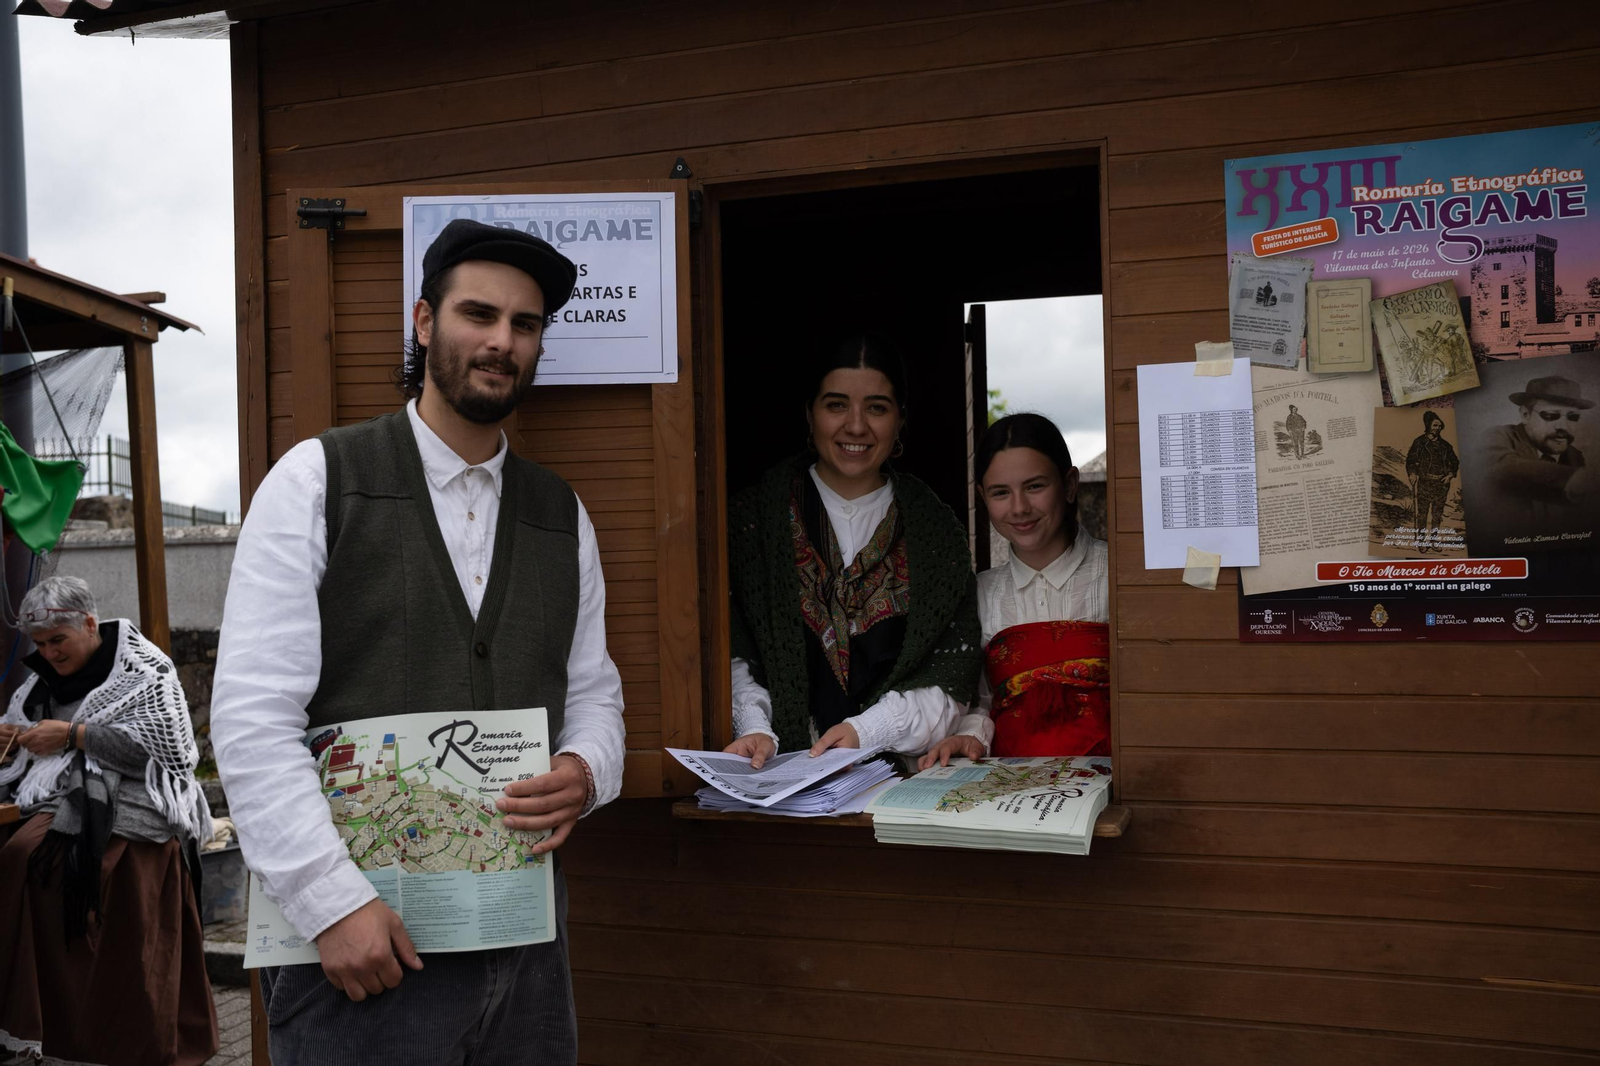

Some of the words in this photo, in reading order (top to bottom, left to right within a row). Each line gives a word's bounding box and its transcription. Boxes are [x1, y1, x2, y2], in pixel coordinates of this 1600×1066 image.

[1235, 155, 1402, 230] XXIII
[1353, 182, 1445, 203] Romaría
[1451, 168, 1584, 194] Etnográfica
[494, 206, 560, 218] Romaría
[565, 203, 652, 219] Etnográfica
[1350, 185, 1588, 265] RAIGAME
[1261, 239, 1293, 250] TURÍSTICO
[1304, 232, 1328, 242] GALICIA
[1263, 234, 1282, 242] FESTA
[1292, 225, 1322, 238] INTERESE
[1332, 250, 1343, 260] 17
[1348, 250, 1358, 259] de
[1360, 248, 1385, 258] maio
[1389, 247, 1399, 256] de
[1402, 244, 1428, 255] 2026
[1324, 262, 1369, 273] Vilanova
[1372, 260, 1388, 270] dos
[1391, 258, 1436, 269] Infantes
[1411, 268, 1458, 279] Celanova
[571, 286, 623, 300] ARTAS
[629, 286, 636, 298] E
[564, 309, 626, 323] CLARAS
[1504, 536, 1531, 545] Valentín
[1561, 531, 1591, 542] Carvajal
[1338, 566, 1349, 577] O
[1352, 565, 1373, 577] Tío
[1376, 564, 1426, 579] Marcos
[1450, 563, 1502, 575] Portela
[1414, 582, 1445, 590] xornal
[1460, 582, 1491, 592] galego
[471, 740, 542, 754] Etnográfica
